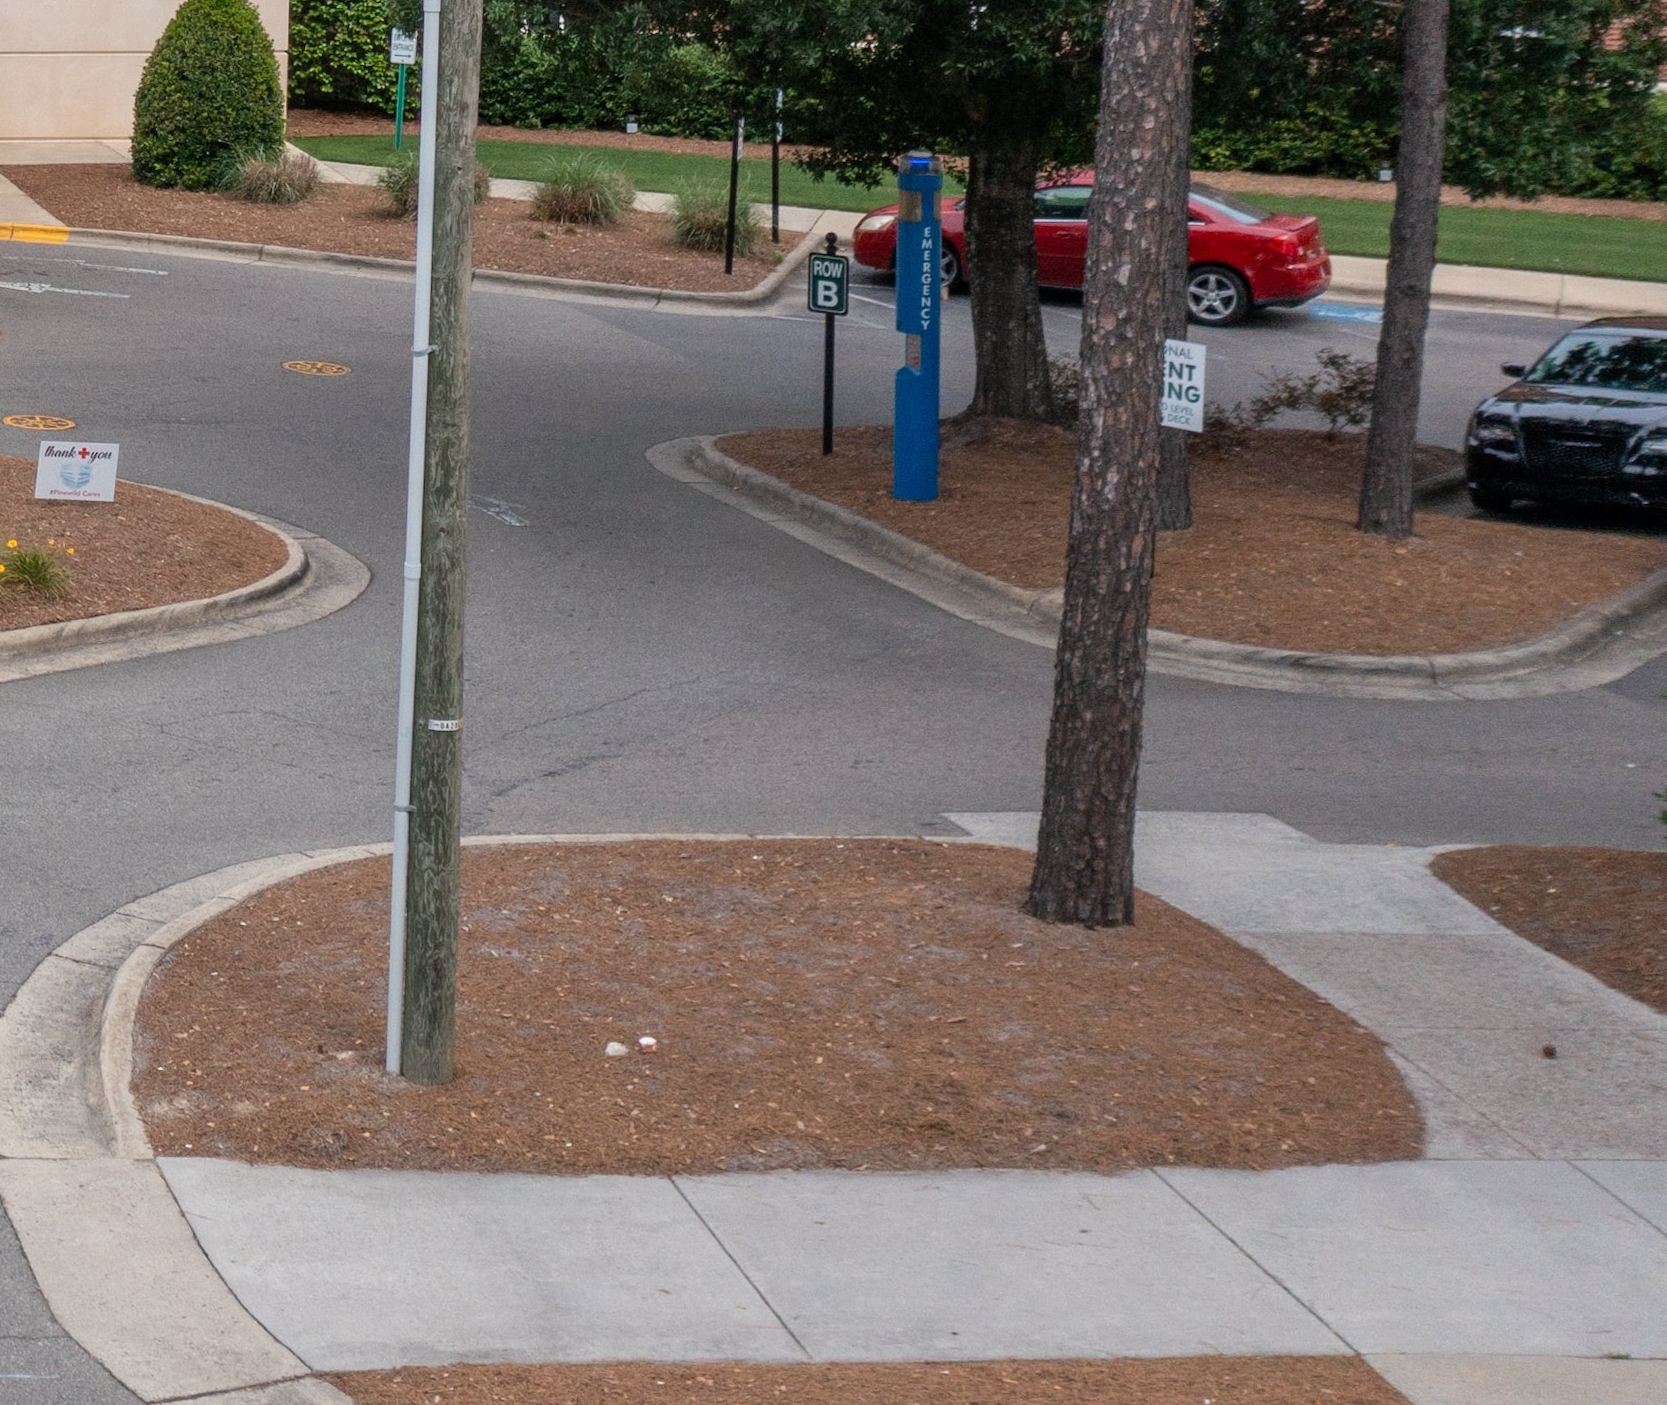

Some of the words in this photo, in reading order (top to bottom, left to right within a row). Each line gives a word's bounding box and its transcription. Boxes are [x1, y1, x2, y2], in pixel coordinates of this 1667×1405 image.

[814, 261, 843, 278] ROW
[921, 227, 932, 330] EMERGENCY
[817, 280, 838, 307] B
[44, 446, 77, 458] thank
[89, 452, 112, 463] you
